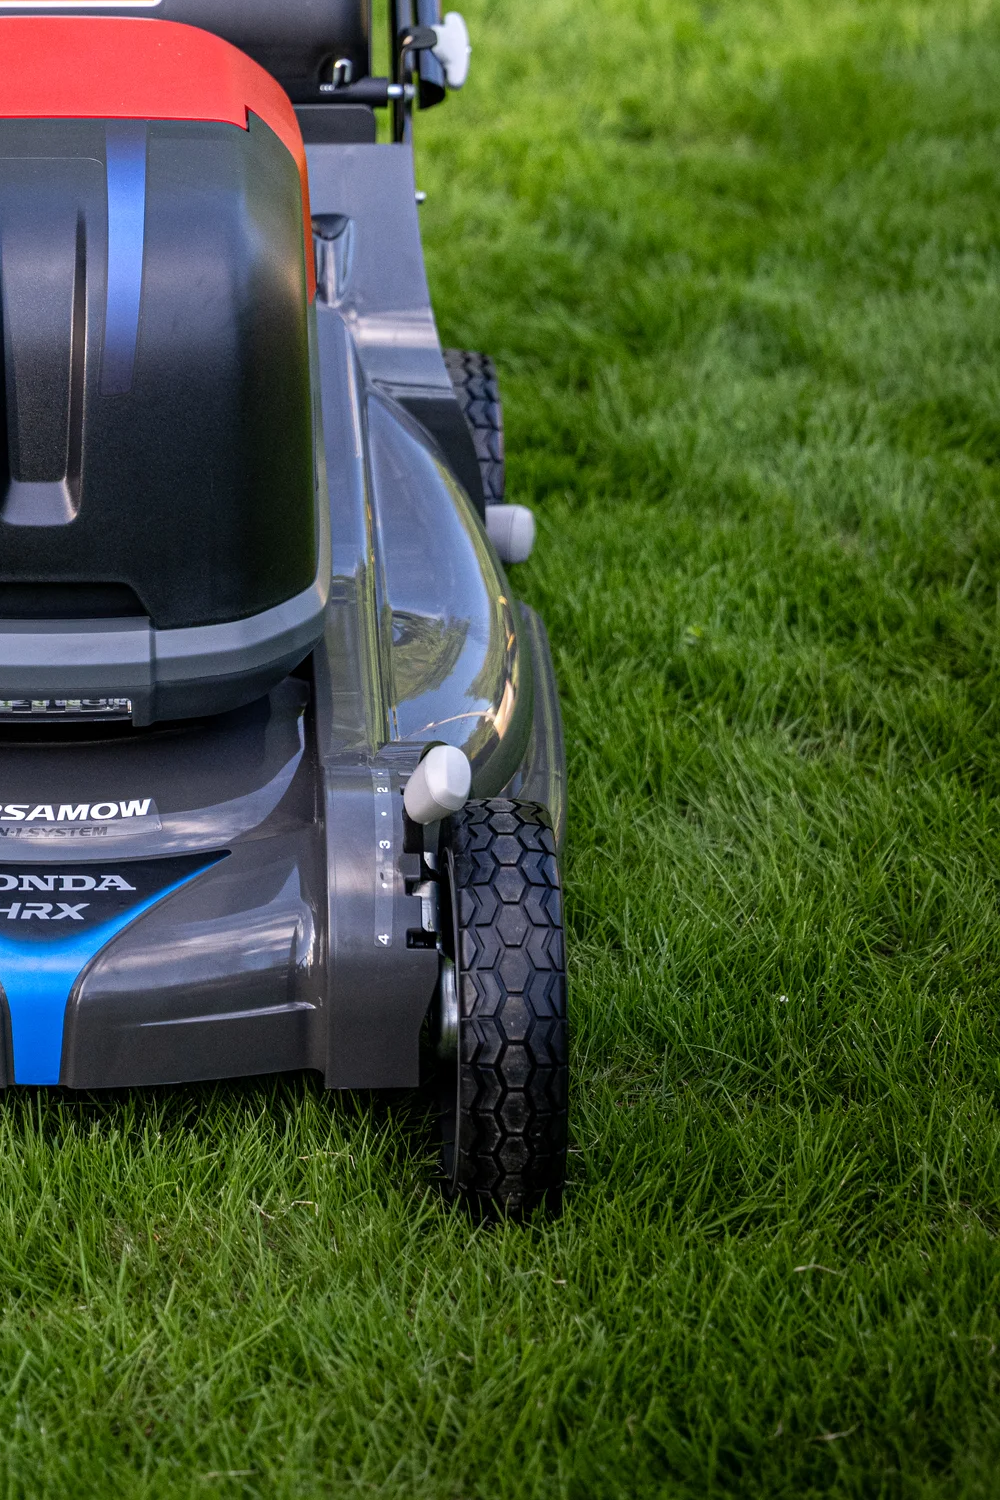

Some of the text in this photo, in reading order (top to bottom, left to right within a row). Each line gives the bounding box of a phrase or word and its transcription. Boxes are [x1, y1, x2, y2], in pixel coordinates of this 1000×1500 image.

[28, 826, 108, 837] SYSTEM
[379, 840, 391, 849] 3
[378, 934, 389, 945] 4
